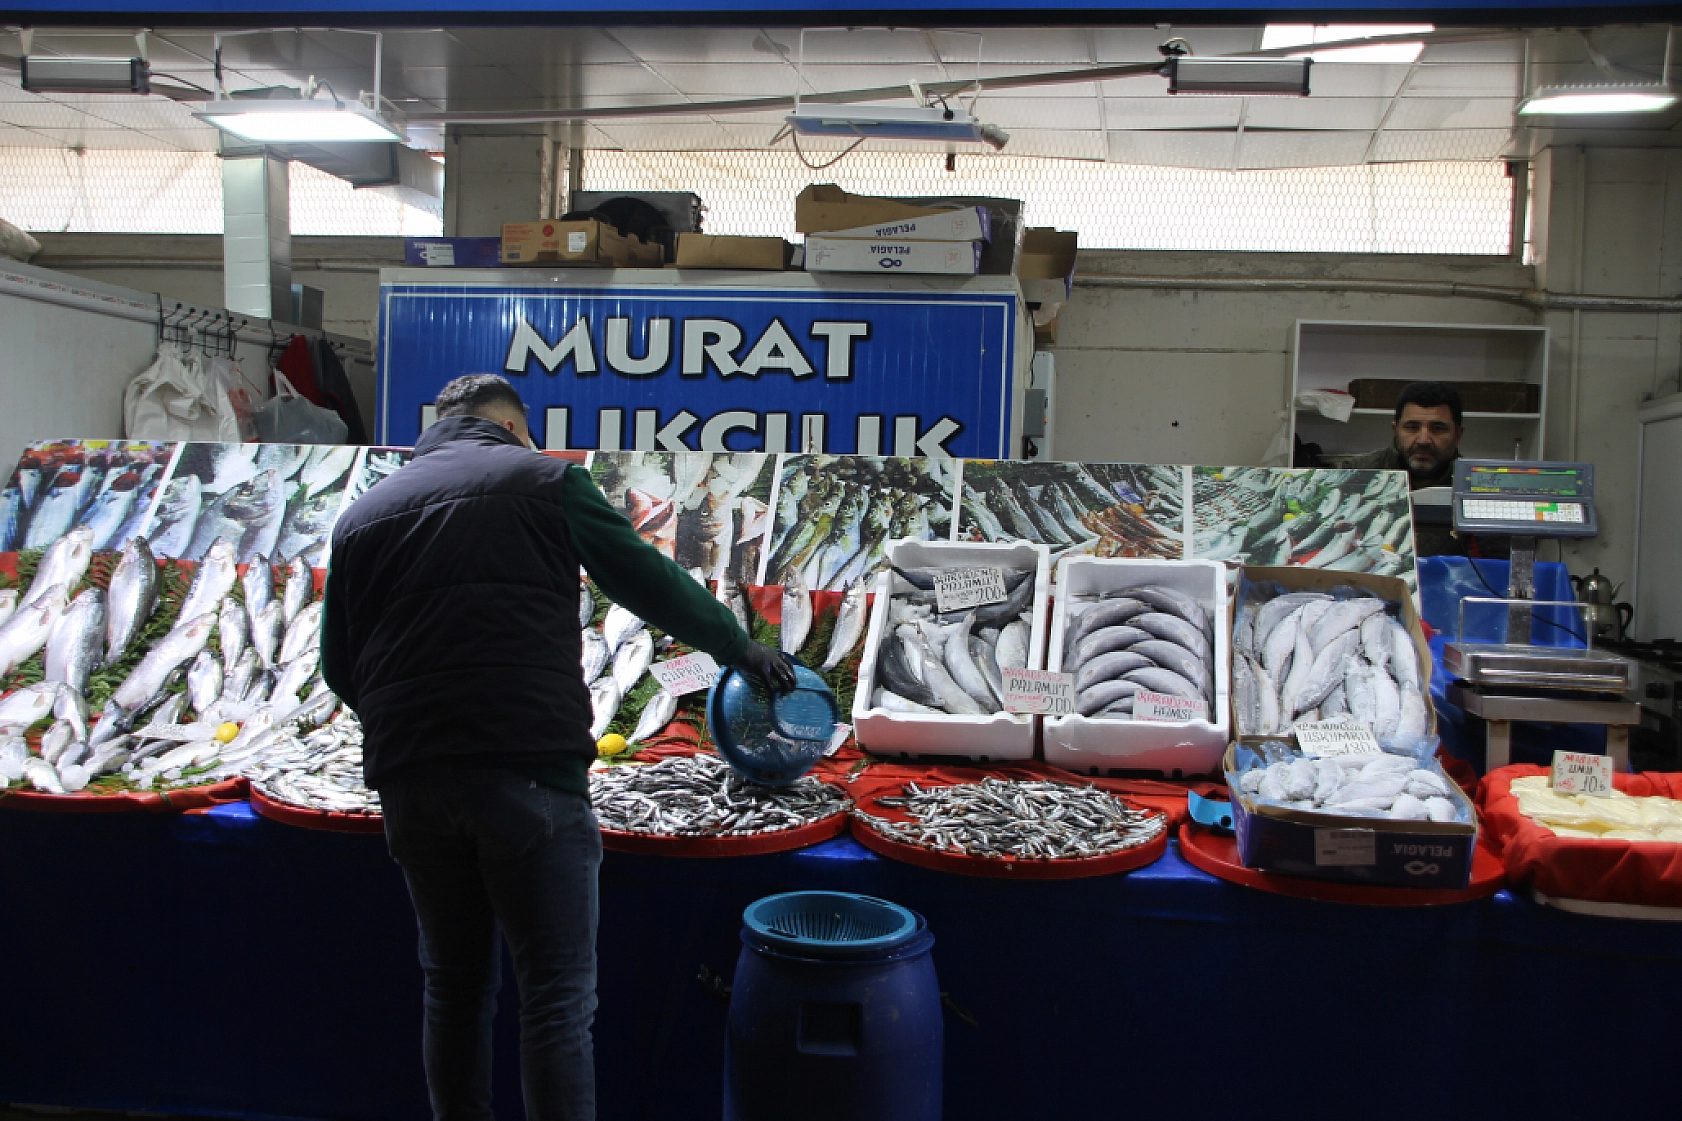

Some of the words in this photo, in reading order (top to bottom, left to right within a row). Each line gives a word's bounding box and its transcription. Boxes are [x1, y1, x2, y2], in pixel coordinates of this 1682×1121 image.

[876, 224, 916, 237] PELAGIA
[869, 245, 911, 255] PELAGIA
[505, 318, 868, 377] MURAT
[1010, 678, 1070, 696] PALAMUT
[1390, 843, 1452, 857] PELAGIA
